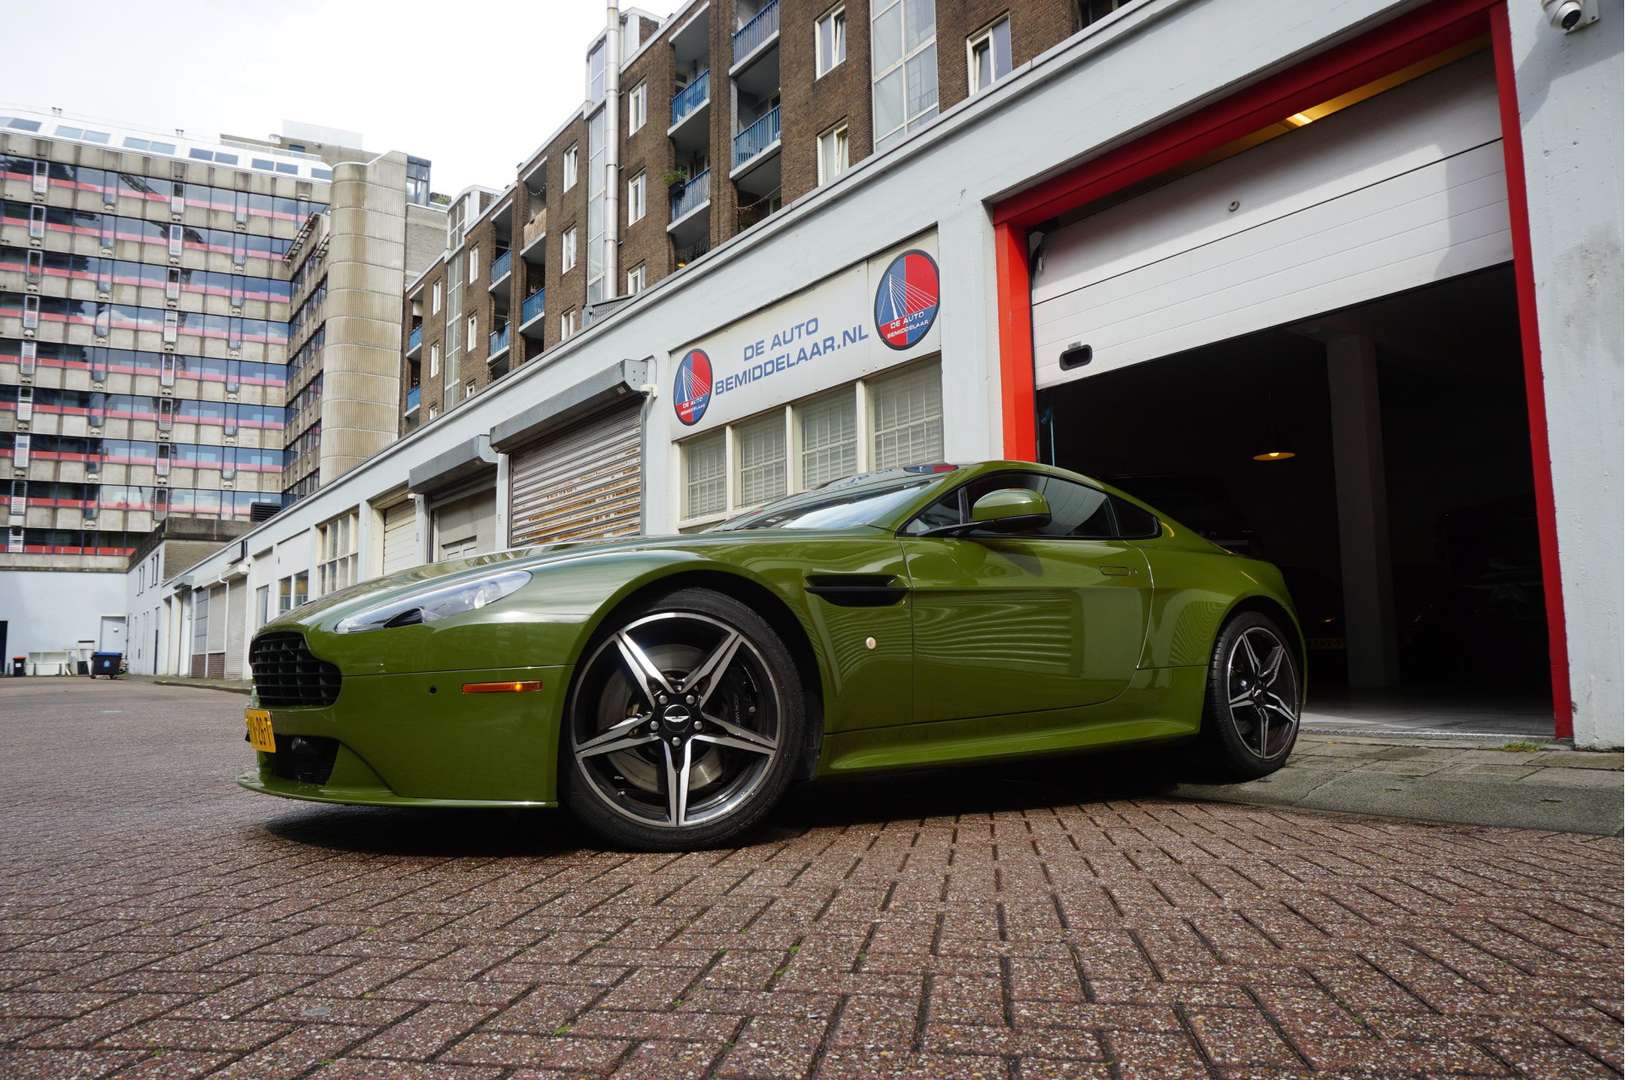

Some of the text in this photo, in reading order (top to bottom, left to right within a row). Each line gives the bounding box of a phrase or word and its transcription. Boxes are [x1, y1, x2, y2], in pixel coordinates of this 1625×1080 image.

[743, 317, 818, 362] DE AUTO
[890, 311, 925, 329] DE AUTO
[715, 324, 869, 396] BEMIDDELAAR.NL
